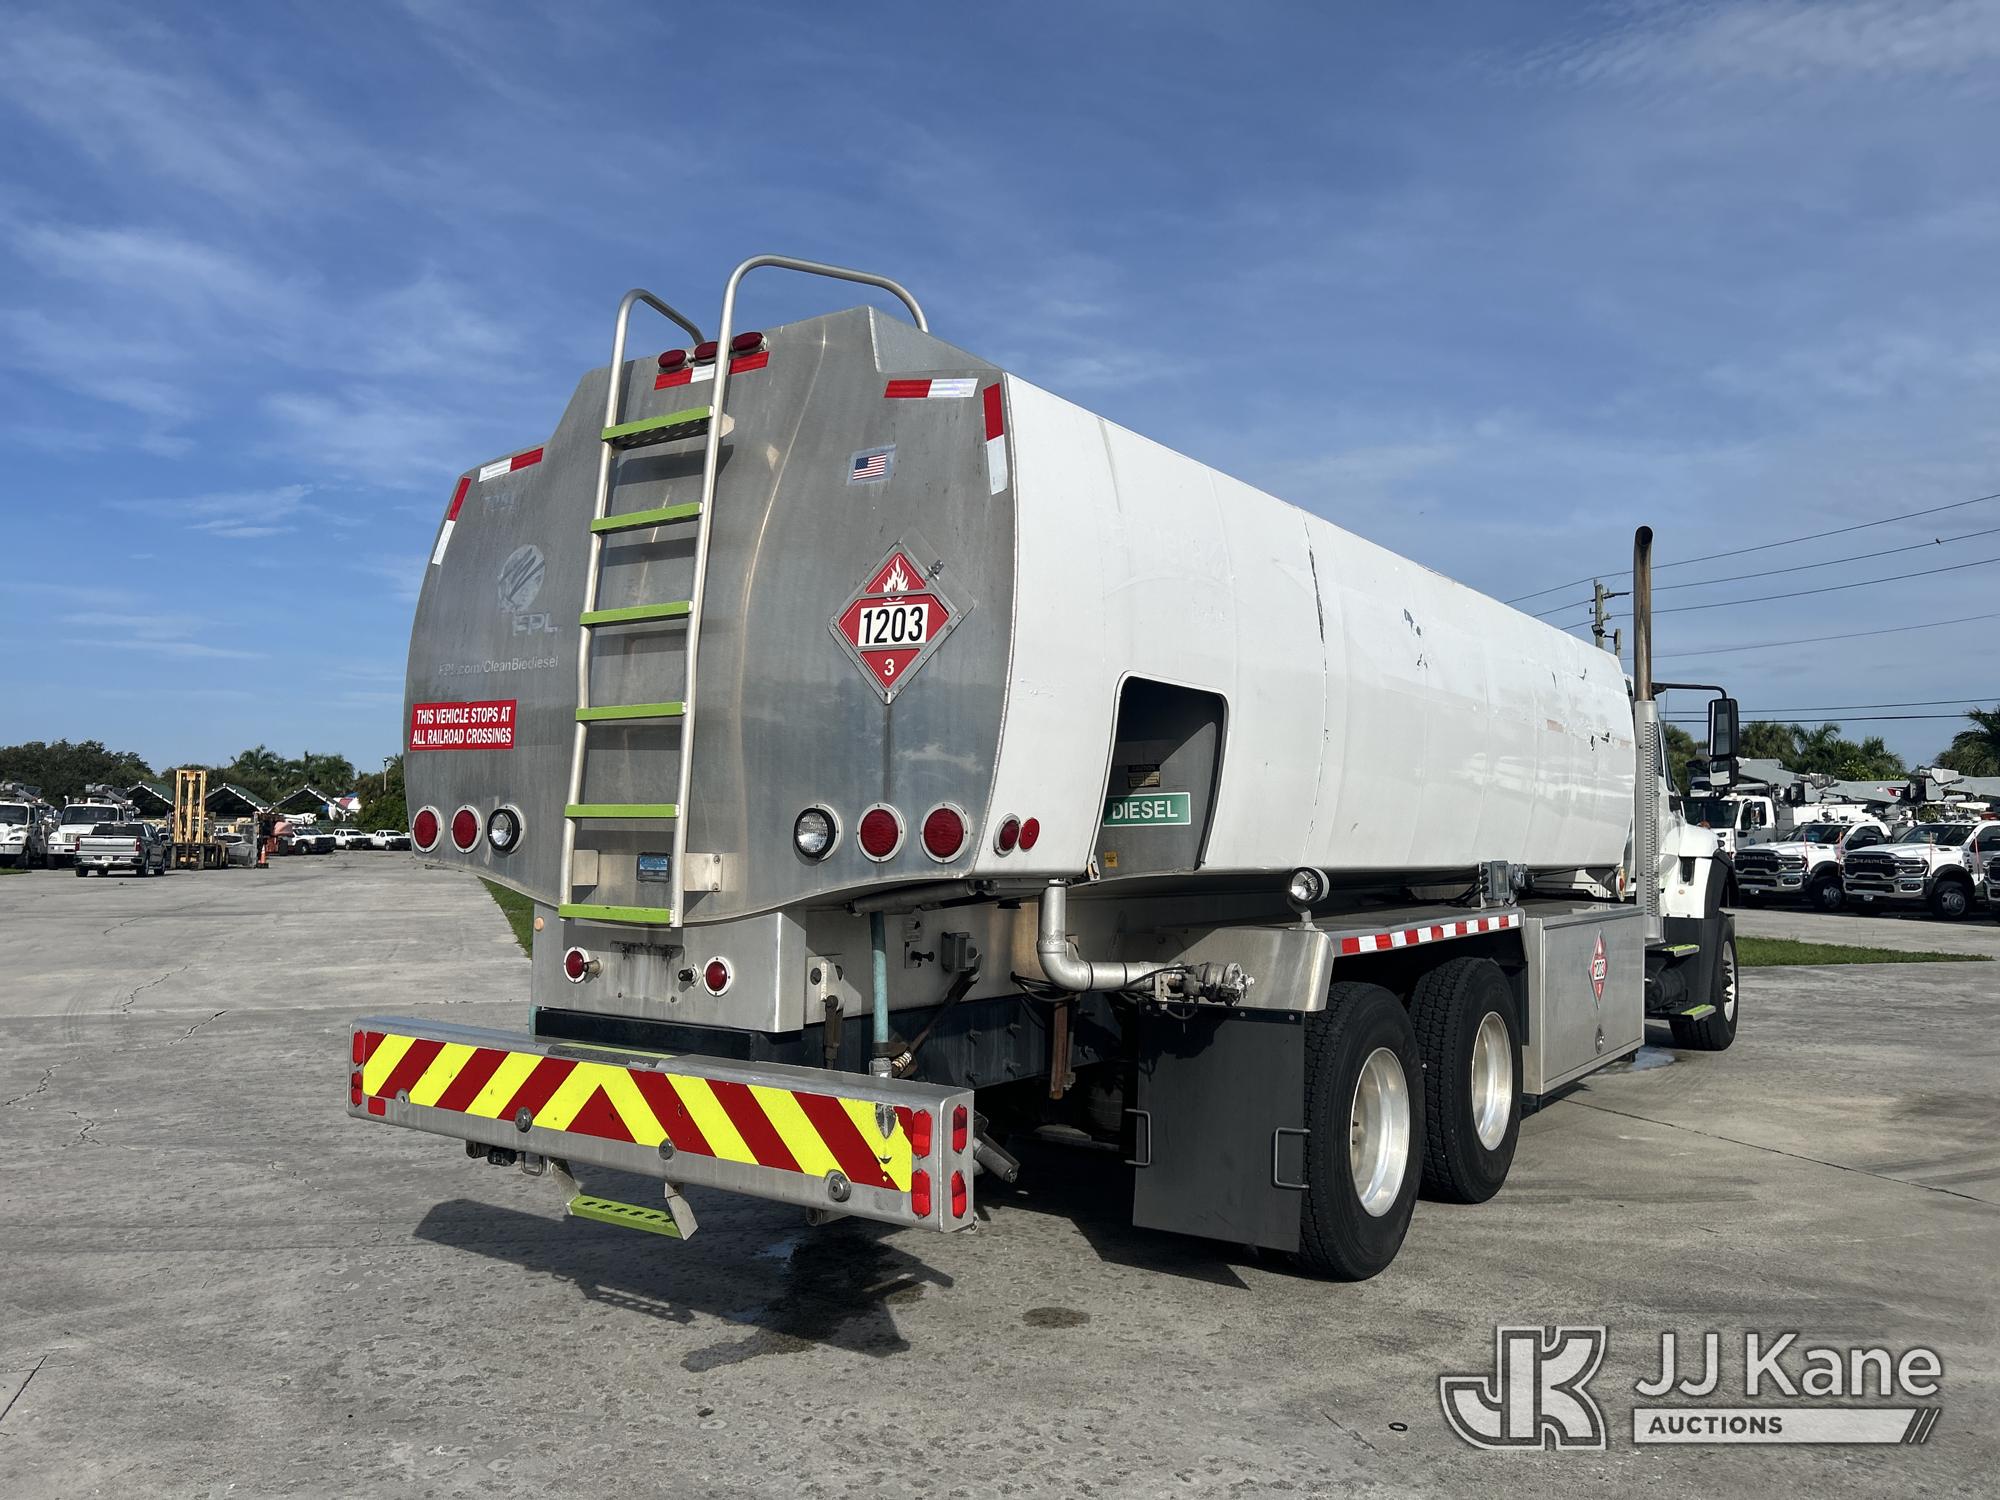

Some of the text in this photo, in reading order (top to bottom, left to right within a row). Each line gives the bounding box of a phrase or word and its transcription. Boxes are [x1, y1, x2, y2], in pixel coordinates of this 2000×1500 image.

[863, 606, 924, 644] 1203
[884, 658, 895, 676] 3
[417, 706, 511, 725] THIS VEHICLE STOPS AT
[412, 728, 512, 745] ALL RAILROAD CROSSINGS
[1112, 800, 1178, 820] DIESEL
